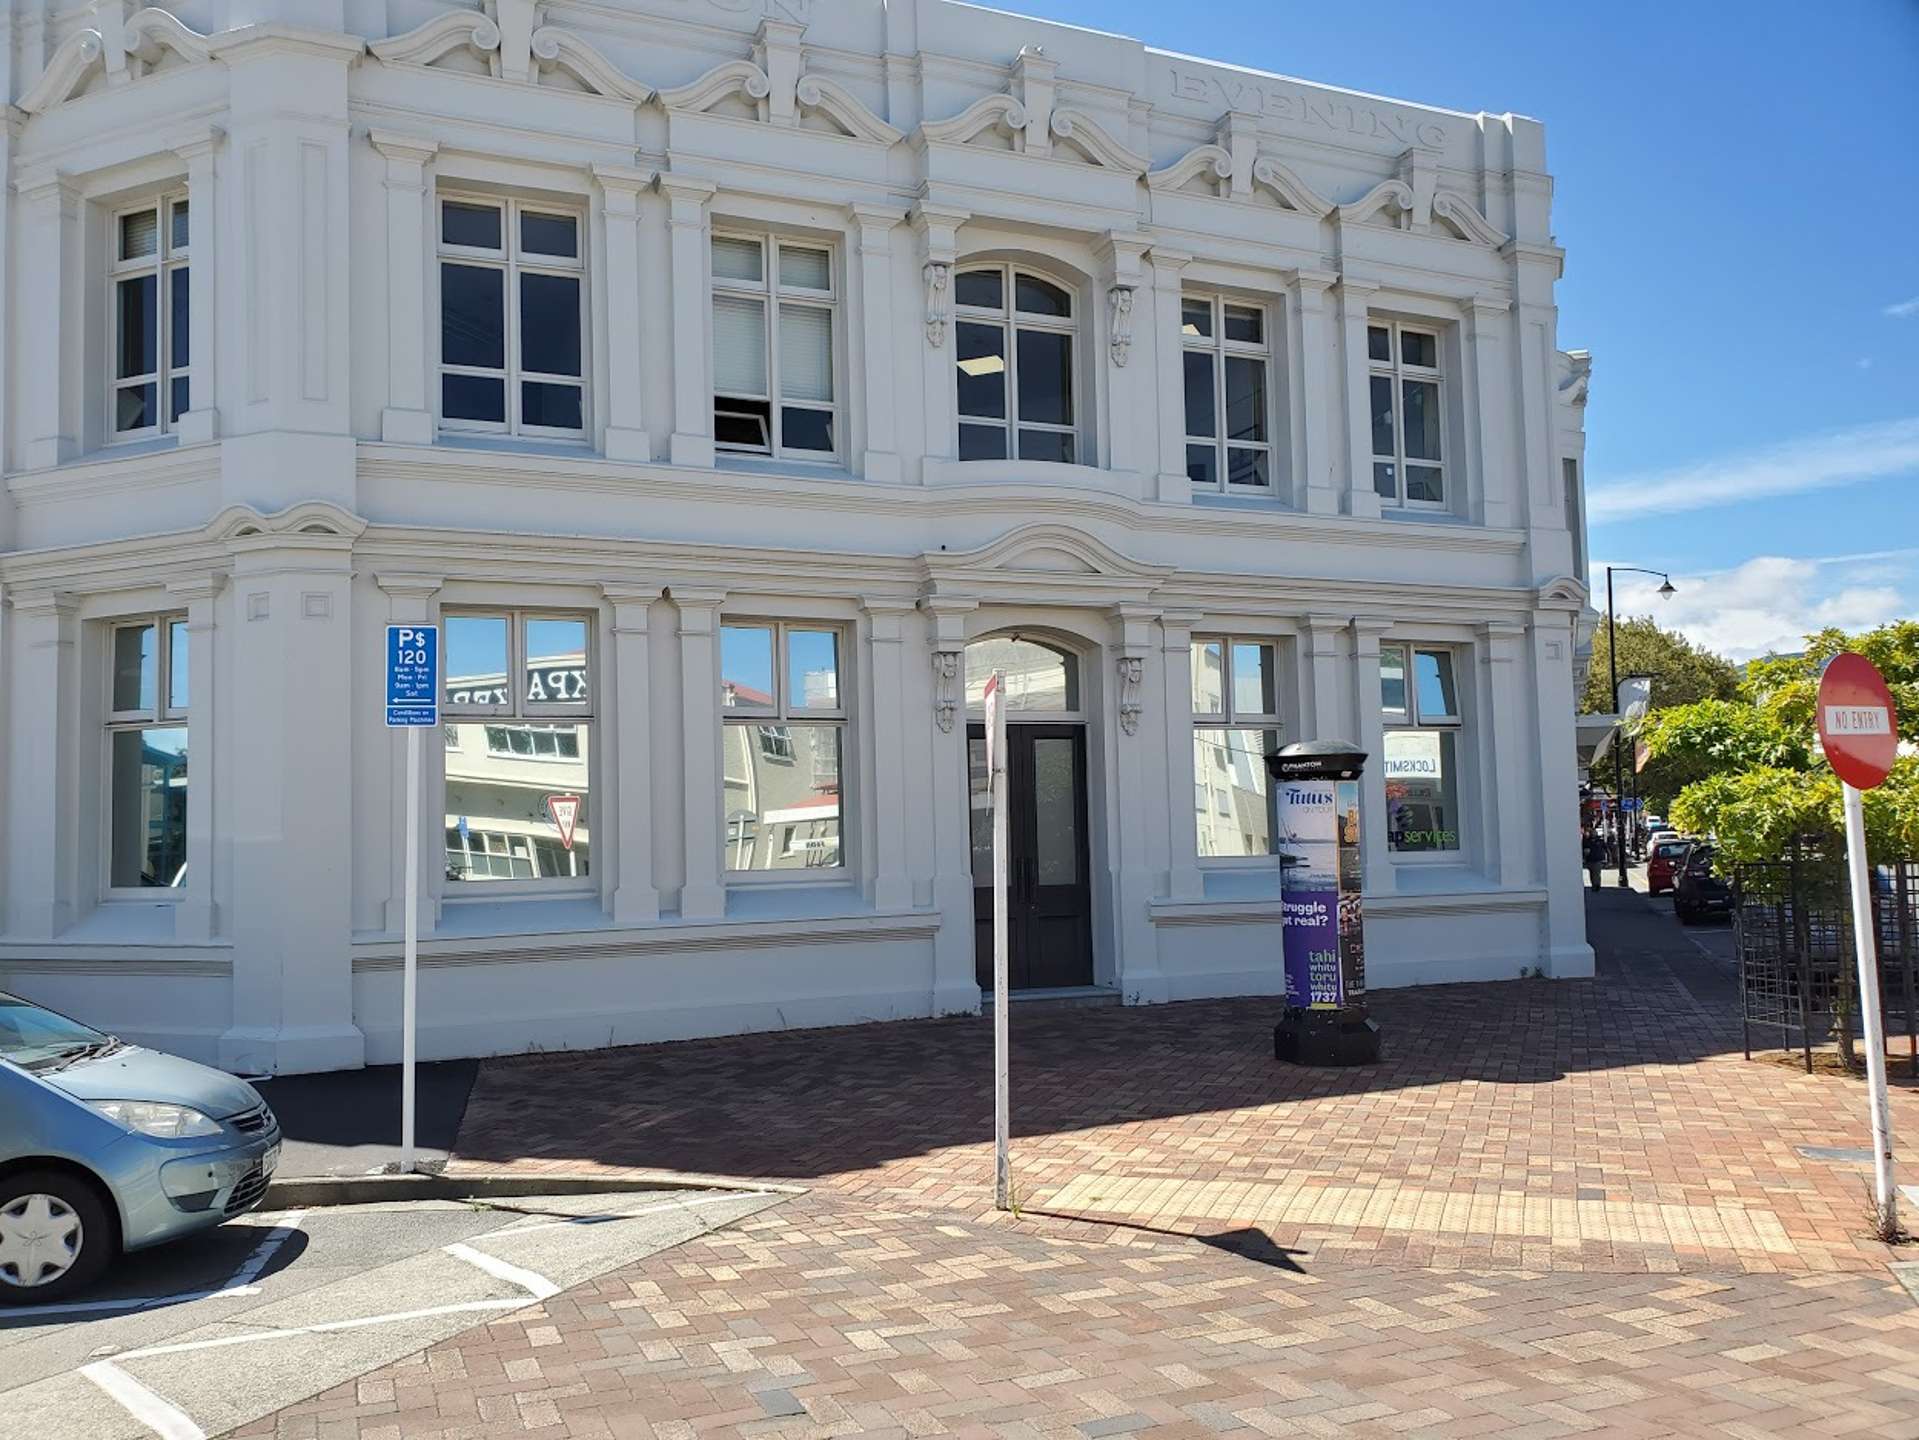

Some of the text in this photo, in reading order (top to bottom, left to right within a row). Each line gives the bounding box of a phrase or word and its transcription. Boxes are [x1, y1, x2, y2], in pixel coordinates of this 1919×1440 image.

[1170, 69, 1447, 150] EVENING
[398, 650, 426, 664] 120
[1835, 711, 1880, 729] NO ENTRY
[1283, 901, 1327, 915] truggle
[1294, 914, 1329, 926] real?
[1309, 949, 1336, 963] tahi
[1310, 962, 1336, 972] whitu
[1310, 973, 1336, 982] toru
[1311, 992, 1337, 1003] 1737
